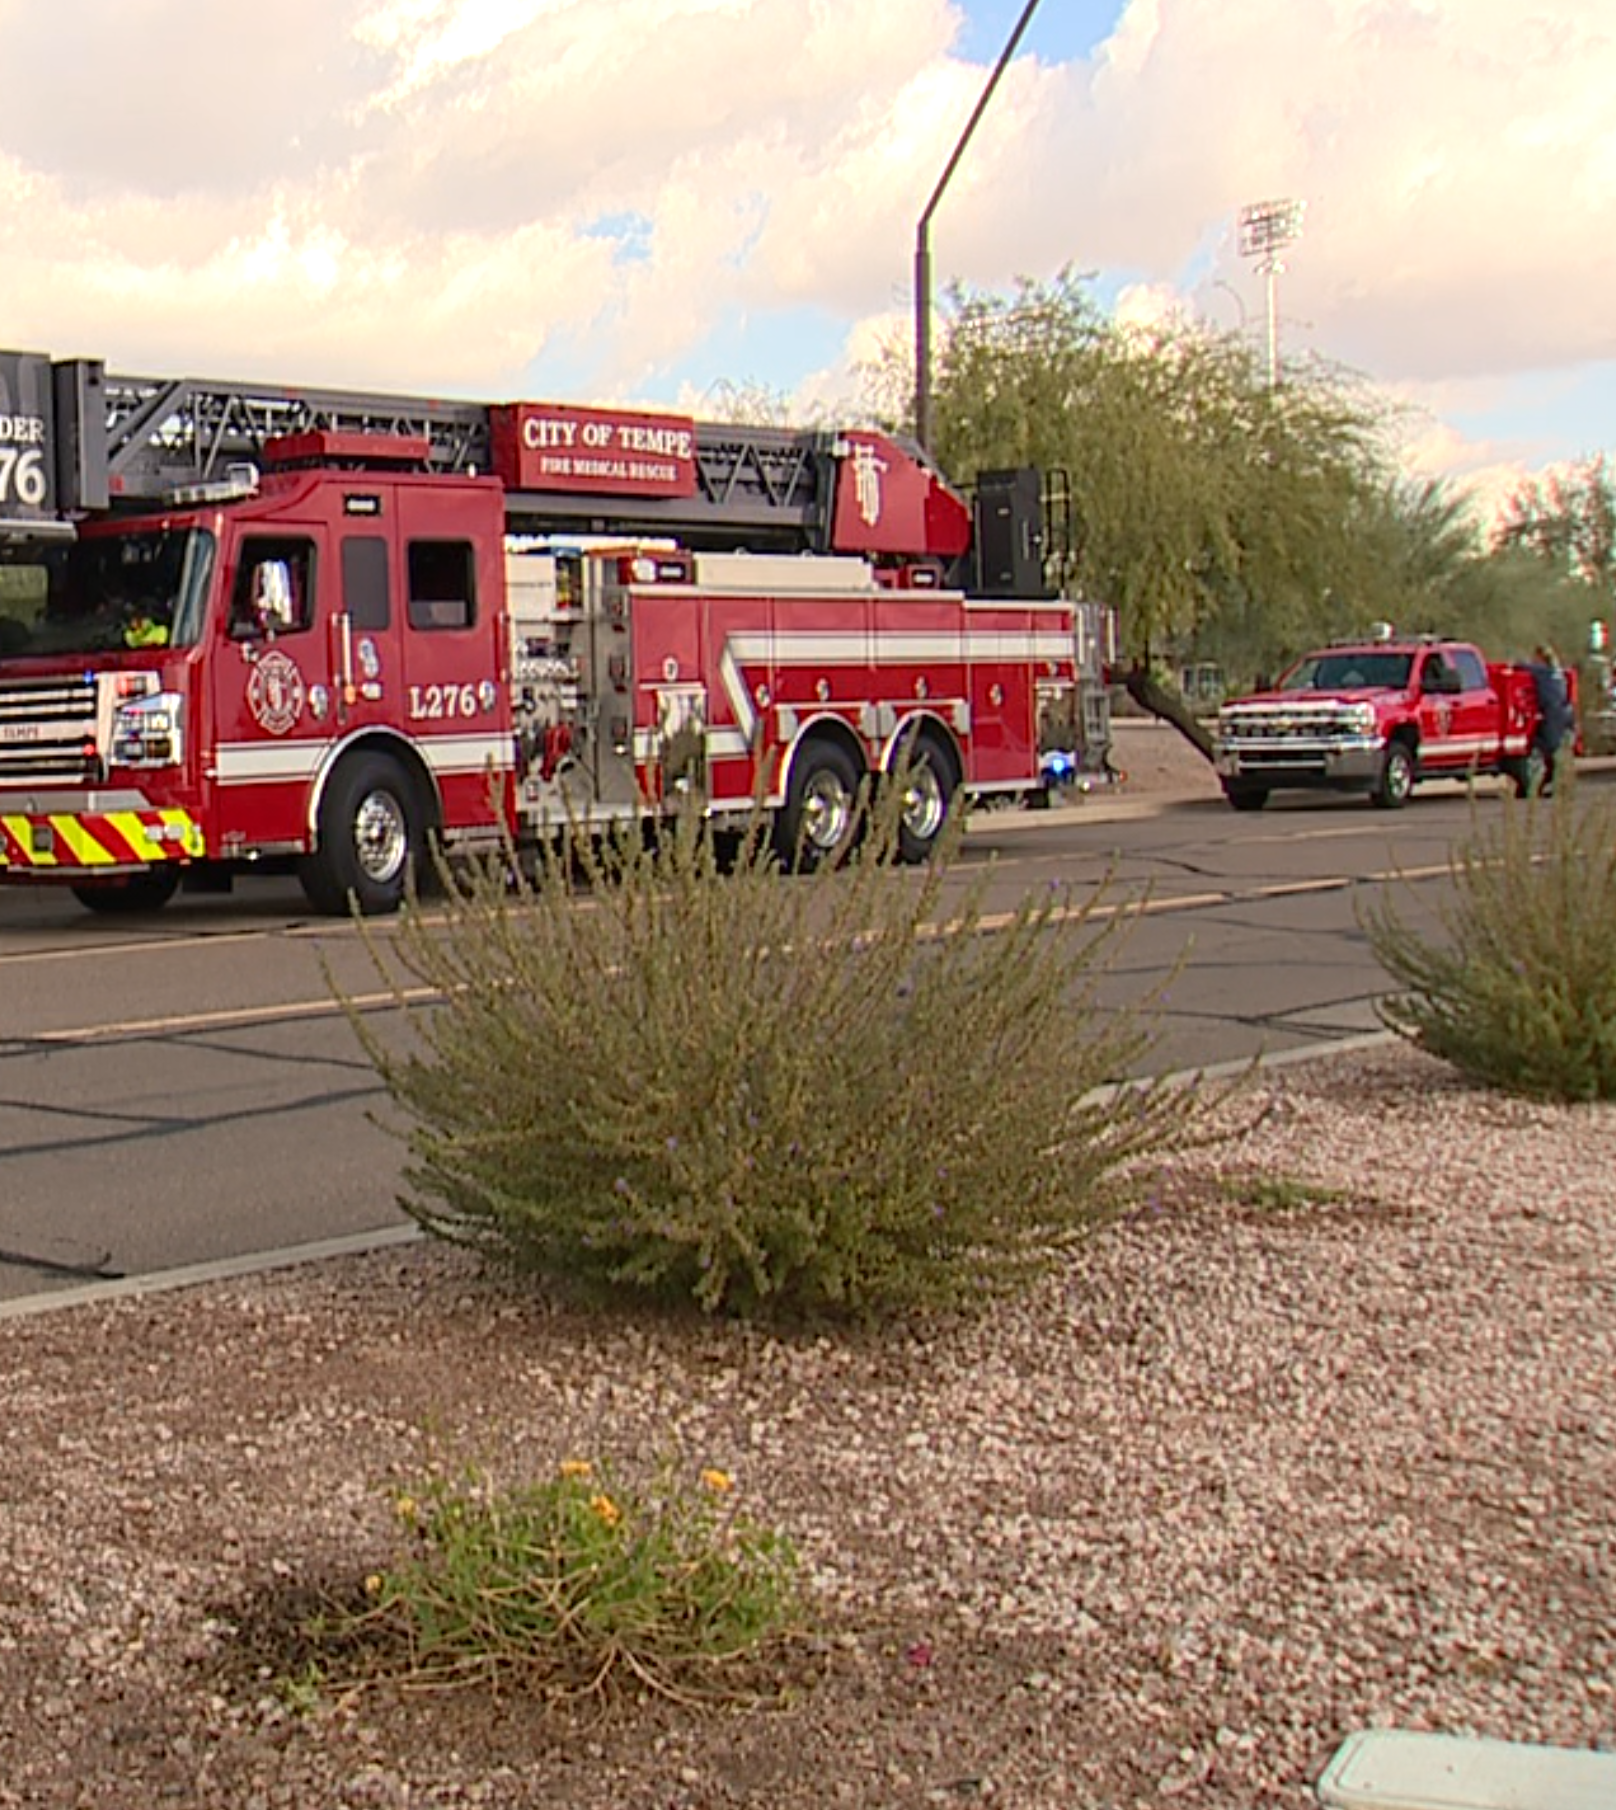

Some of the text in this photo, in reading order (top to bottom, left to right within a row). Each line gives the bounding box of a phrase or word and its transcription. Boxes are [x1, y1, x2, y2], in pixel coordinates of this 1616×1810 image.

[524, 418, 691, 459] CITY OF TEMPE
[540, 456, 677, 482] FIRE MEDICAL RESCUE
[410, 683, 476, 719] L276
